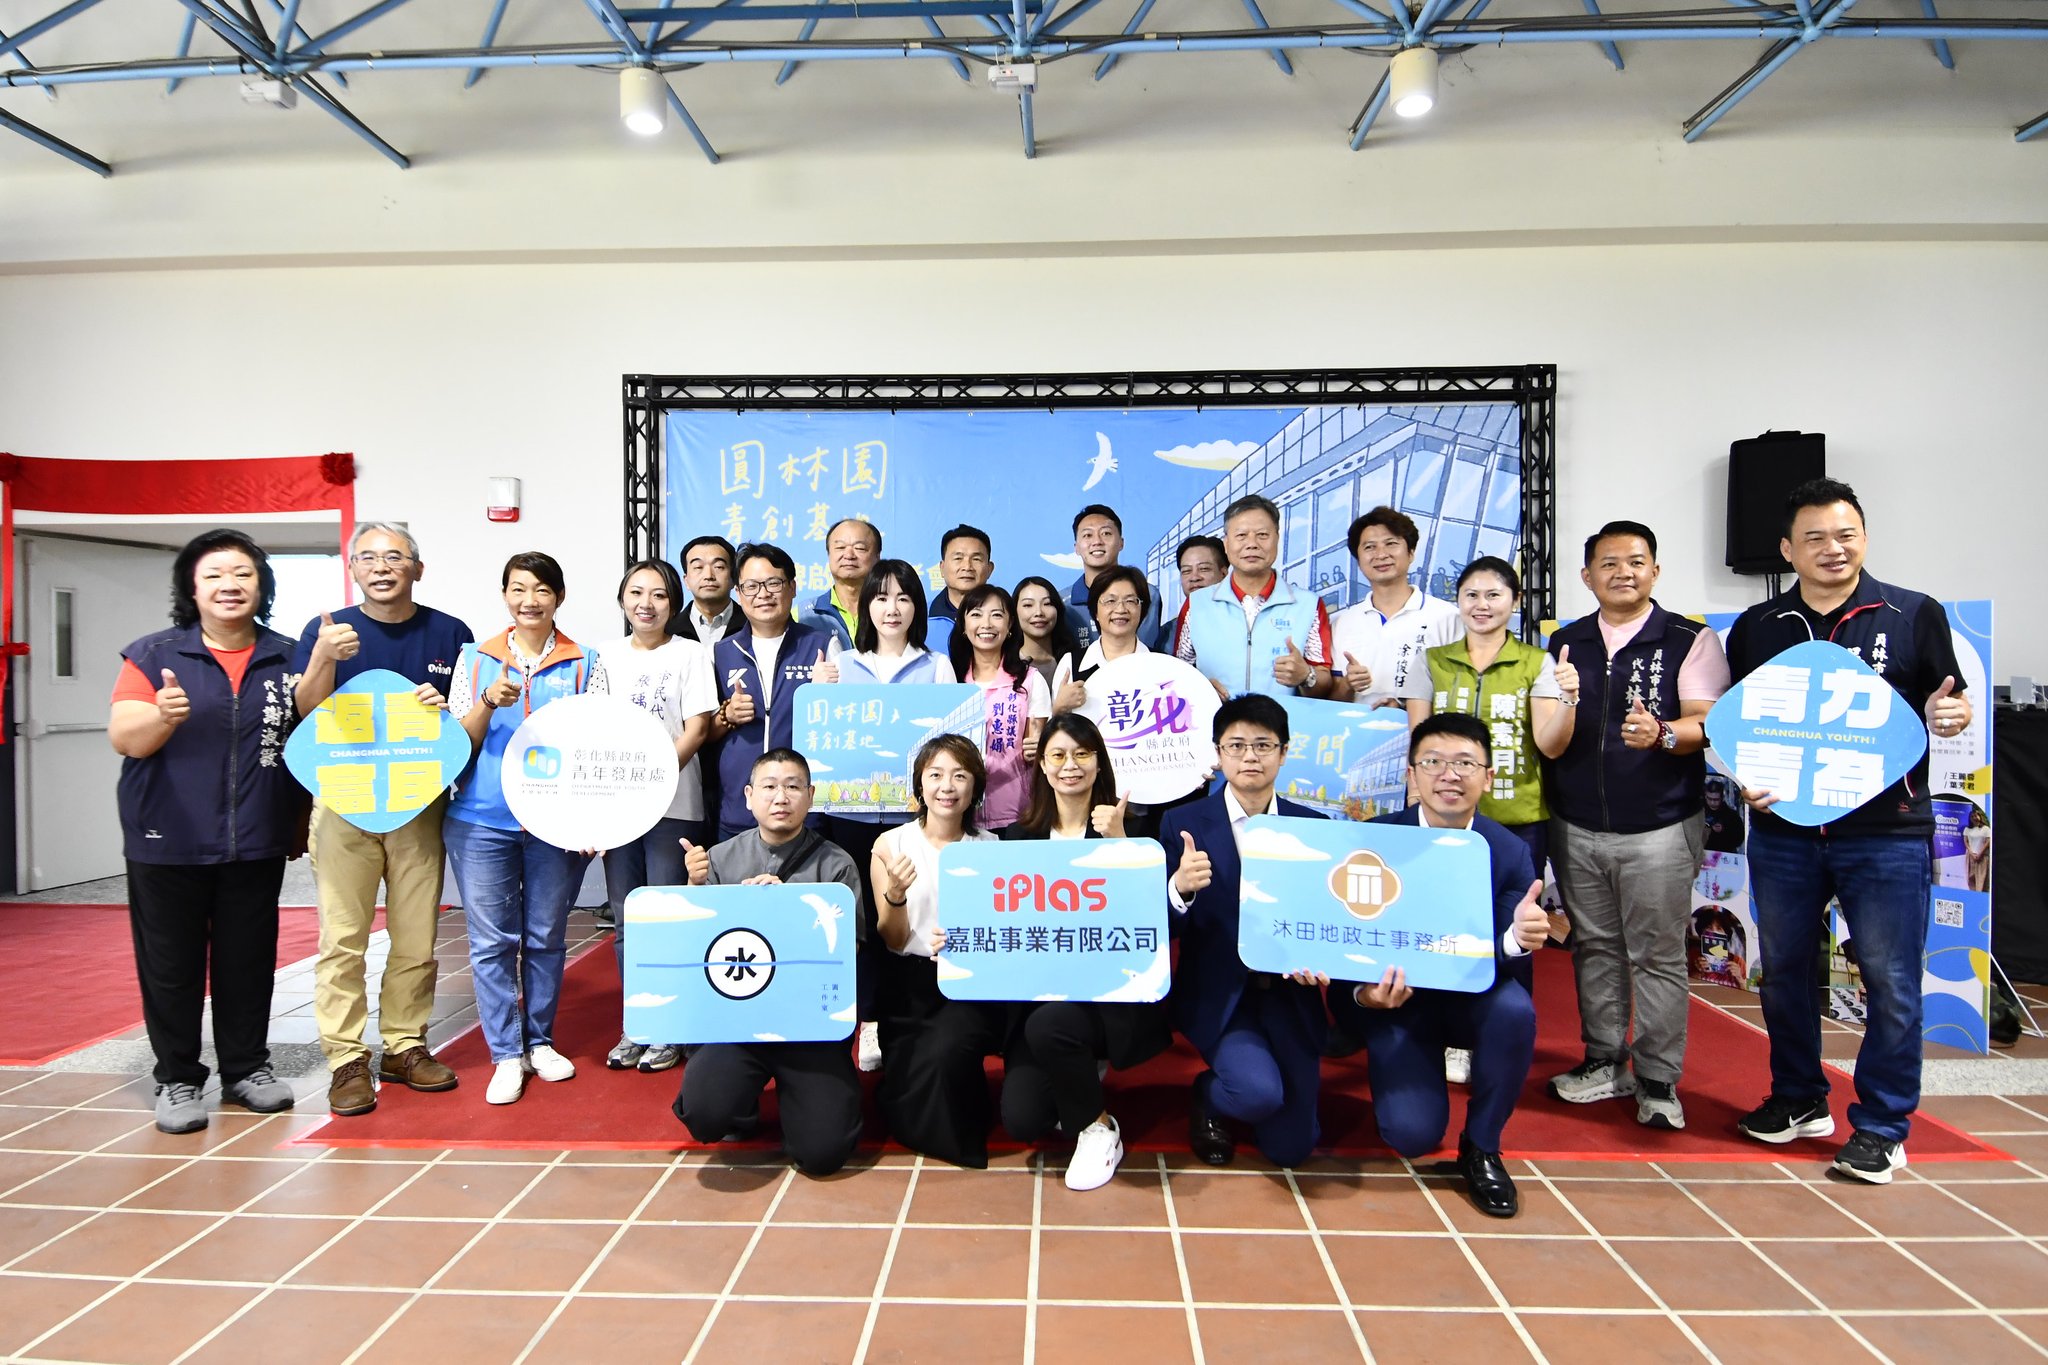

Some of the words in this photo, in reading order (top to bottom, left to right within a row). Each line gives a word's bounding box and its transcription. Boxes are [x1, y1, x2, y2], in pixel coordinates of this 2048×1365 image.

[720, 440, 887, 499] 圓林園
[721, 502, 885, 542] 青創基
[427, 663, 451, 675] Orion
[1740, 664, 1893, 729] 青力
[806, 699, 883, 725] 圓林園
[1005, 692, 1018, 750] 彰化縣議員
[1107, 686, 1190, 736] 彰化
[805, 730, 882, 750] 青創基地
[1146, 734, 1191, 751] 縣政府
[1489, 694, 1517, 775] 陳素月
[1753, 727, 1822, 741] CHANGHUA
[1827, 732, 1876, 744] YOUTH!
[329, 748, 391, 758] CHANGHUA
[574, 748, 646, 763] 彰化縣政府
[1112, 751, 1196, 767] HANGHUA
[571, 765, 666, 782] 青年發展處
[993, 873, 1107, 912] iPlas
[947, 926, 1158, 953] 嘉點事業有限公司
[1273, 919, 1458, 954] 沐田地政士事務所
[724, 947, 757, 981] 水
